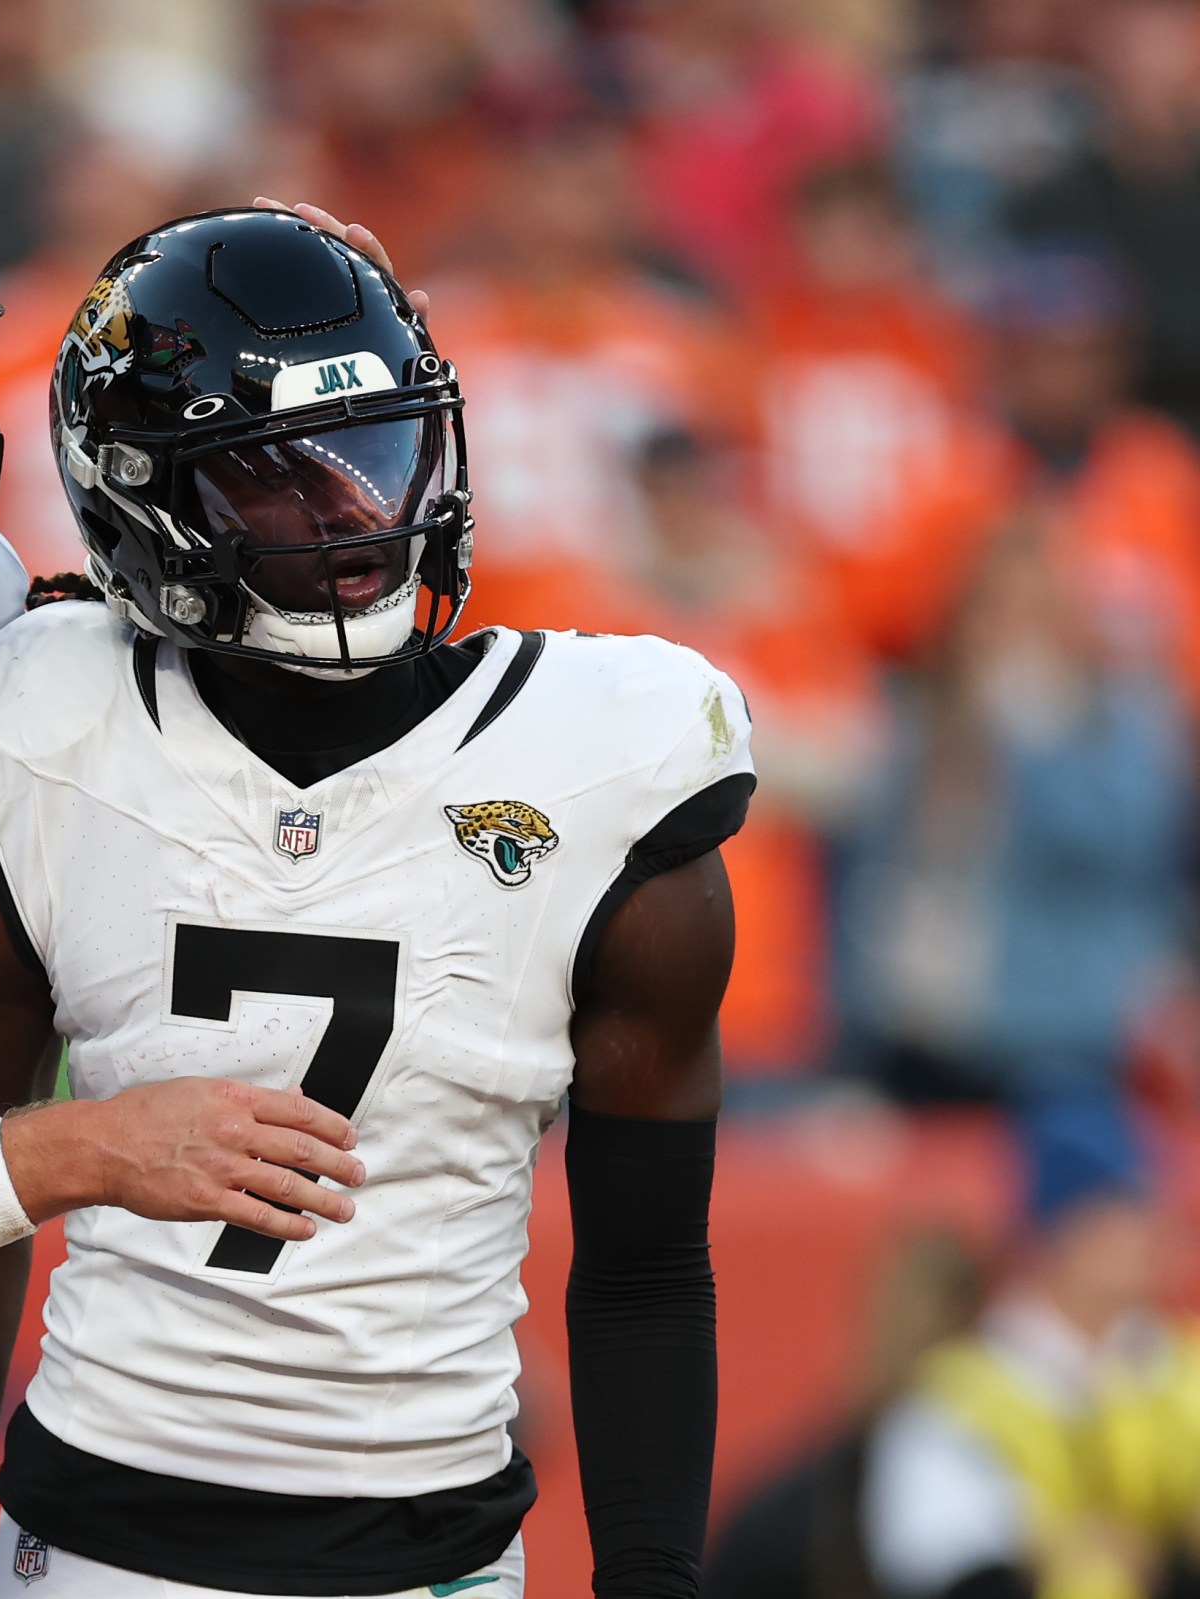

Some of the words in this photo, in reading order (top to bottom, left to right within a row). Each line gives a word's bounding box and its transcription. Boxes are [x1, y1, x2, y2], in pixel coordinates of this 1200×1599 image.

[314, 360, 363, 395] JAX
[281, 828, 313, 852] NFL
[171, 923, 400, 1274] 7
[17, 1551, 41, 1574] NFL
